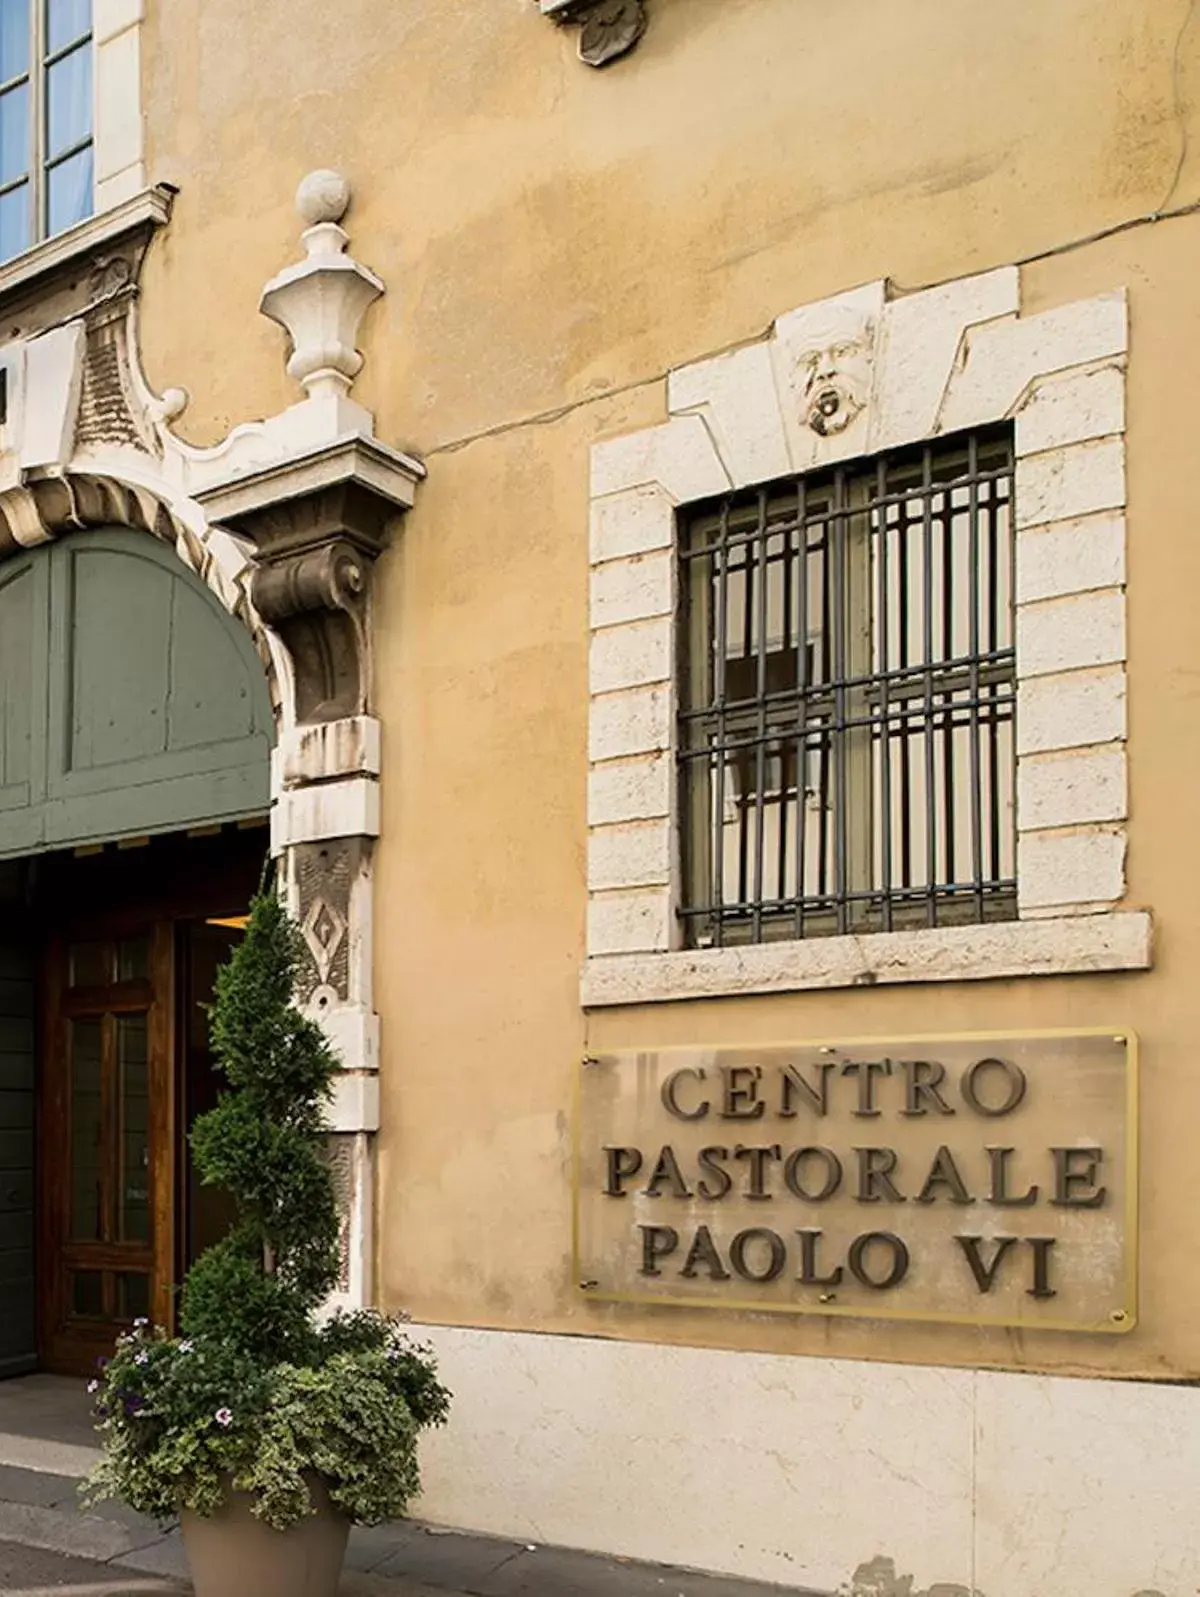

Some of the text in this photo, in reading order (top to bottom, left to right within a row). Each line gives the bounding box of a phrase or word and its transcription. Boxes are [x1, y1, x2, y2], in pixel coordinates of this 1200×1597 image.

[661, 1057, 1026, 1120] CENTRO
[602, 1145, 1107, 1207] PASTORALE
[638, 1225, 1058, 1297] PAOLO VI
